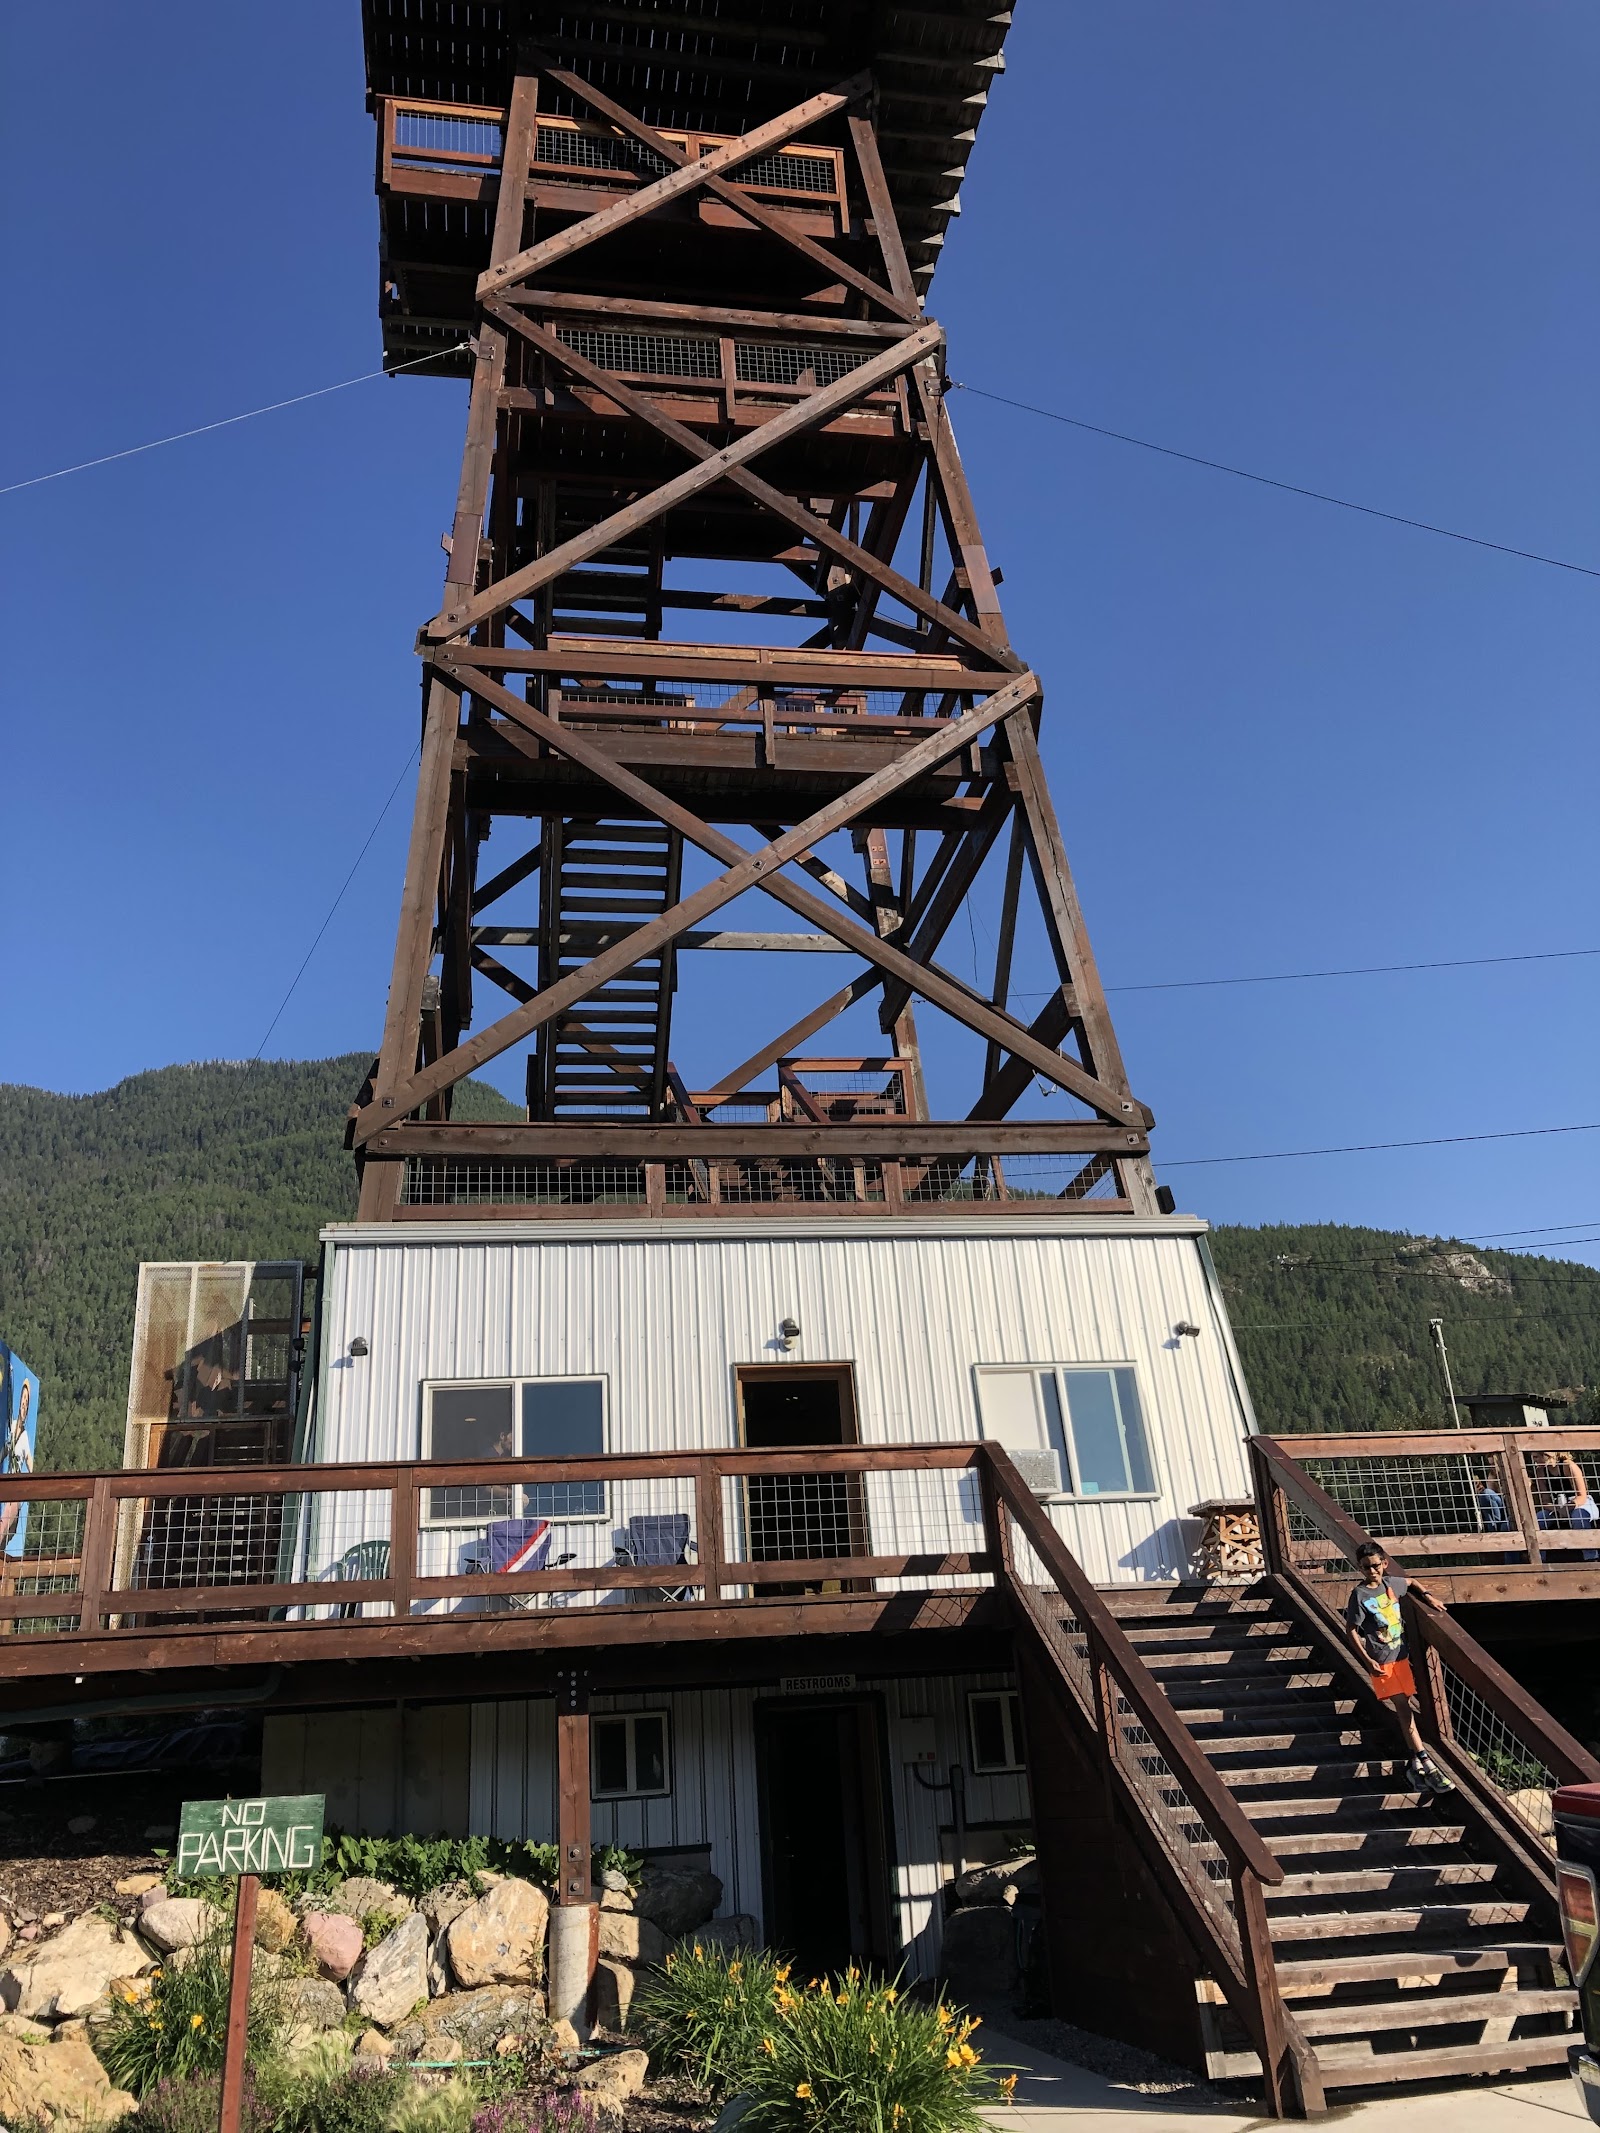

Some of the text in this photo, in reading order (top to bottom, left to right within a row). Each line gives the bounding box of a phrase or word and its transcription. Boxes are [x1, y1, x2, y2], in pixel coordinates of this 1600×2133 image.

[786, 1676, 850, 1690] RESTROOMS
[221, 1802, 266, 1827] NO
[178, 1826, 314, 1874] PARKING
